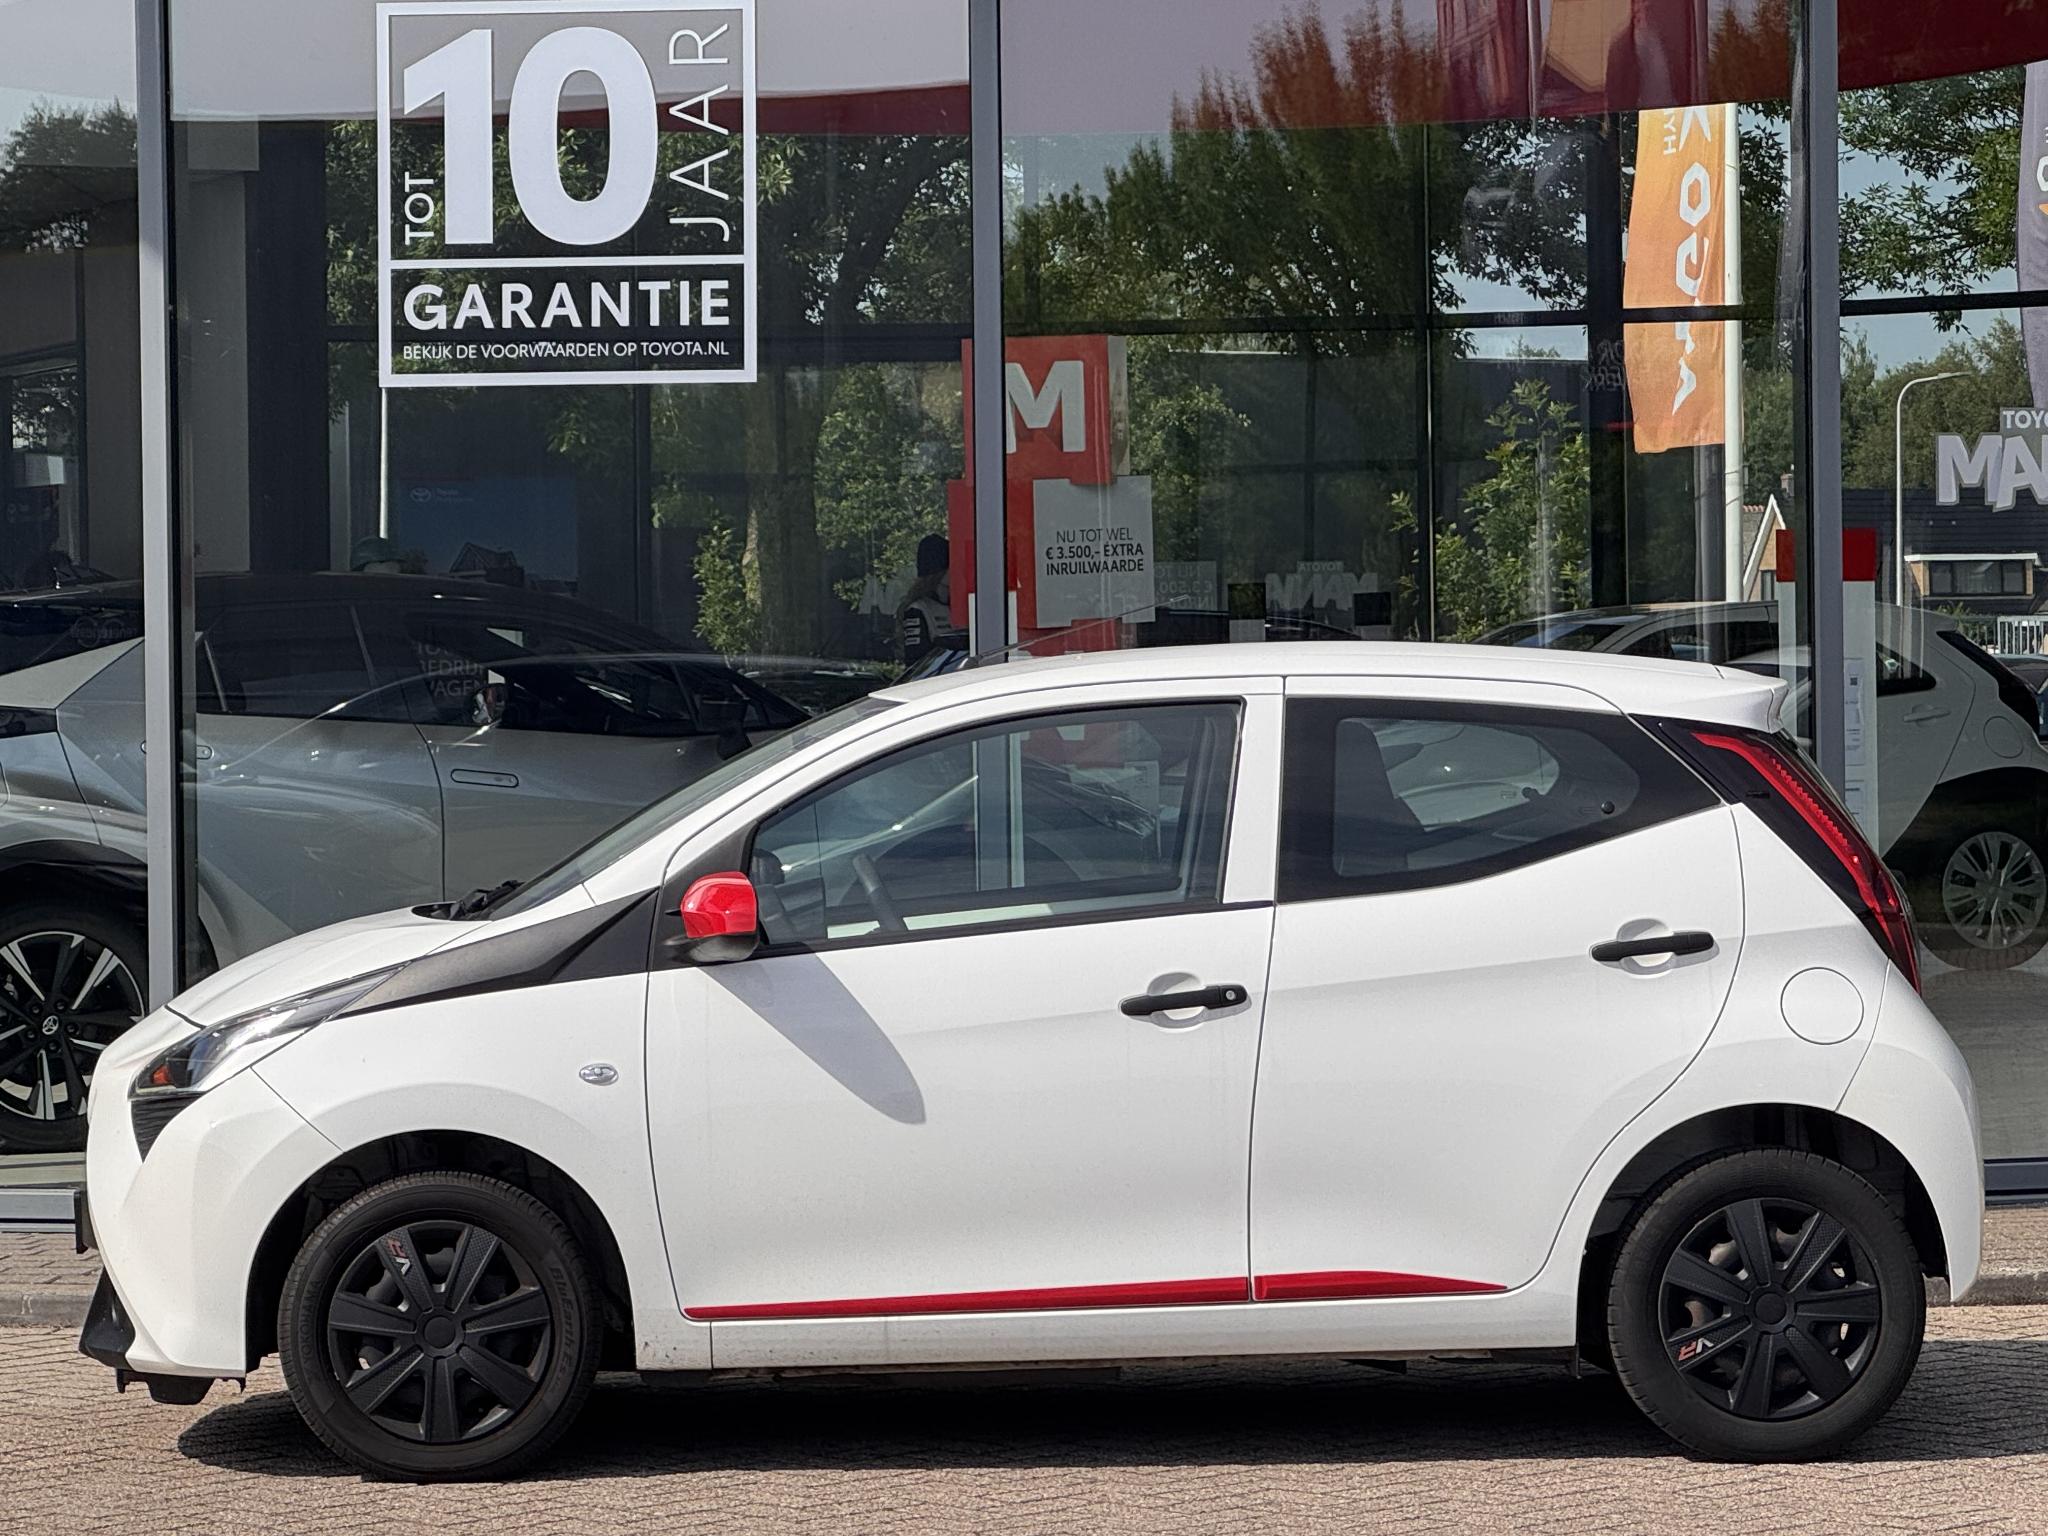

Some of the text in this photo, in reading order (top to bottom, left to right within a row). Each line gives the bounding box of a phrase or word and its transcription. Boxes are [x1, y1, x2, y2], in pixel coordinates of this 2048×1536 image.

[403, 23, 730, 245] TOT 10 JAAR
[403, 280, 730, 330] GARANTIE
[403, 341, 730, 360] BEKIJK DE VOORWAARDEN OP TOYOTA.NL
[1937, 433, 2048, 510] MA
[1056, 526, 1134, 544] NU TOT WEL
[1045, 546, 1054, 560] €
[1056, 544, 1100, 560] 3.500,-
[1045, 558, 1145, 576] INRUILWAARDE
